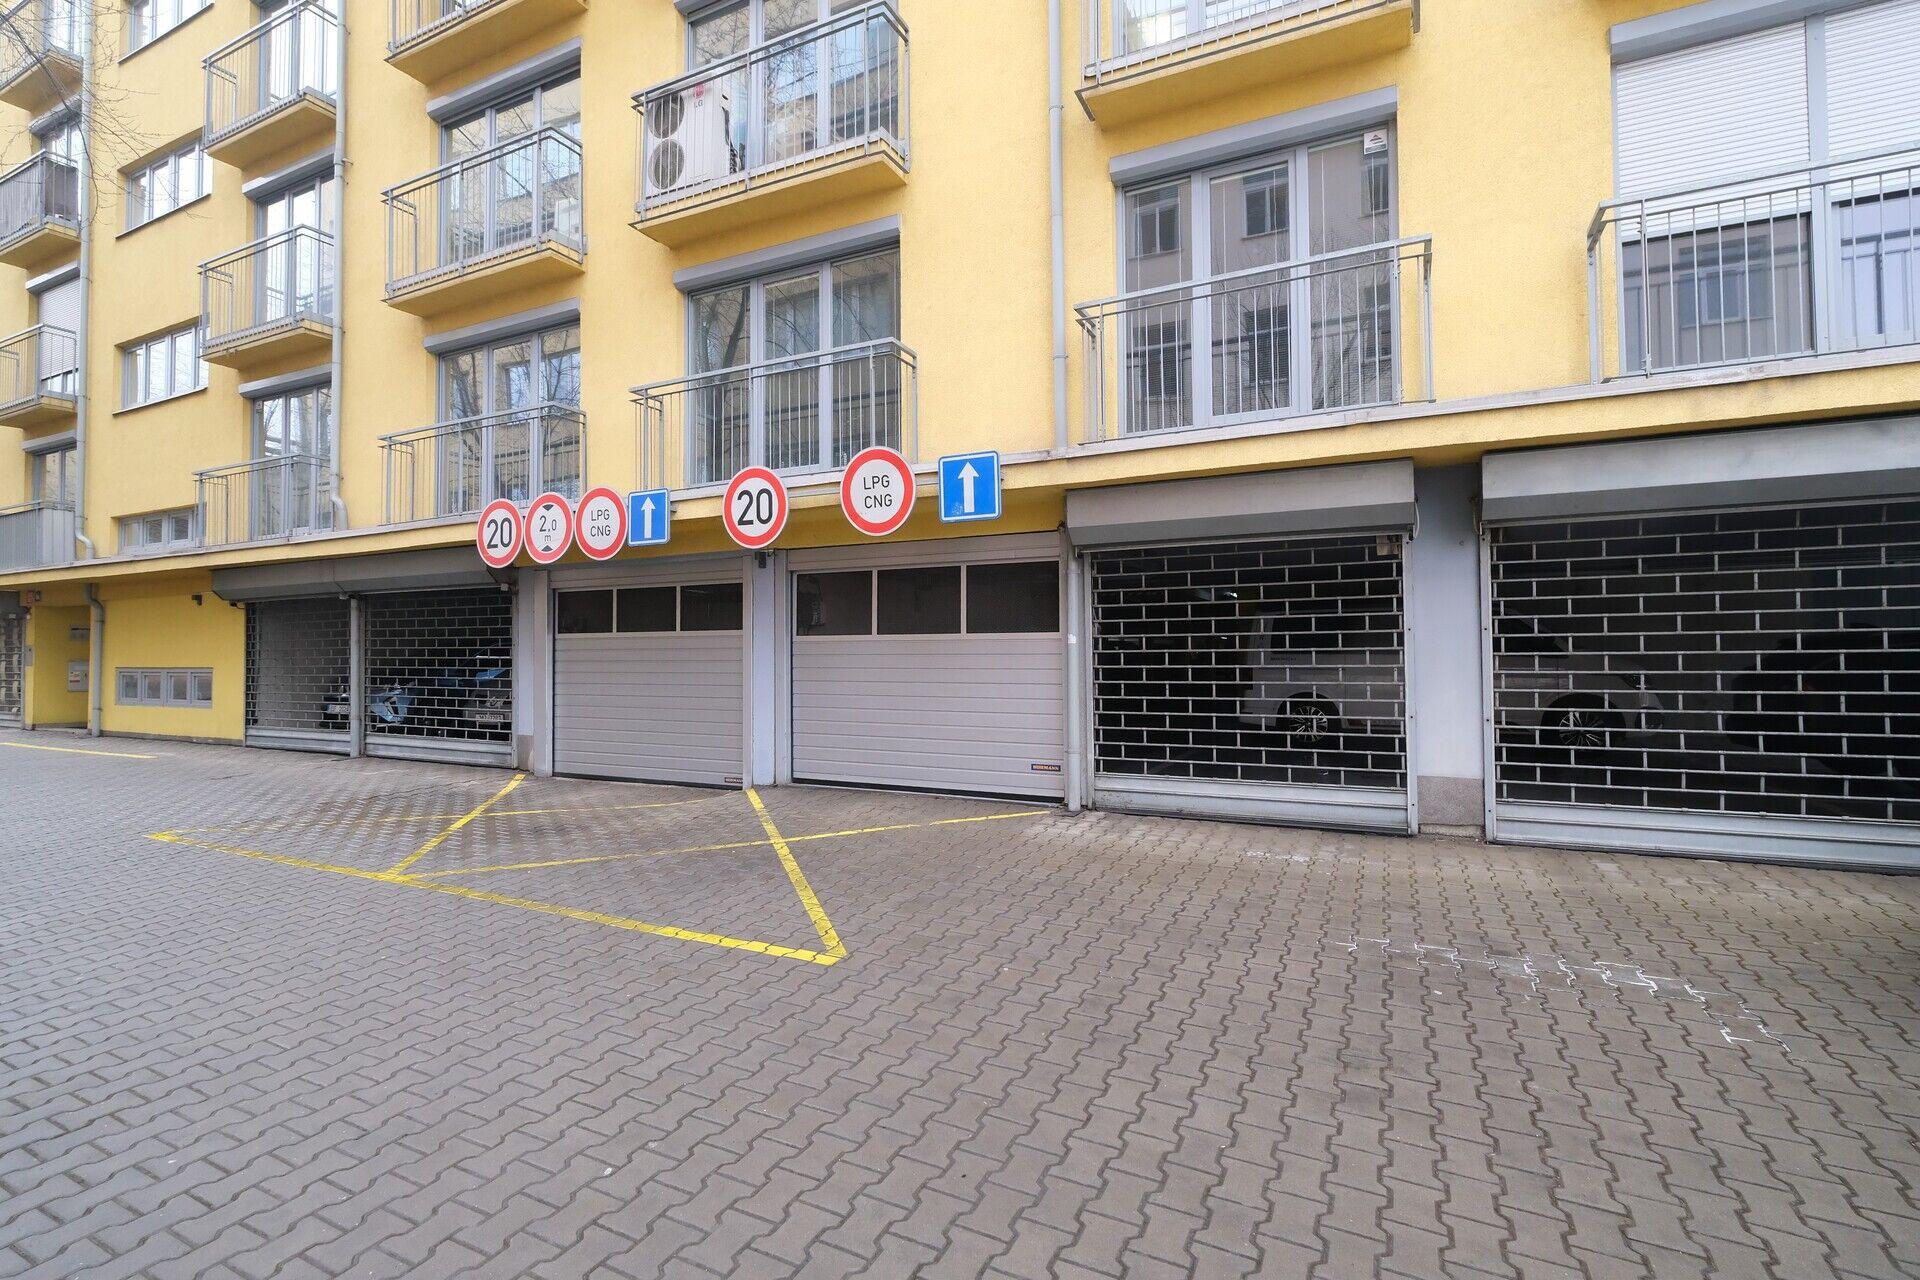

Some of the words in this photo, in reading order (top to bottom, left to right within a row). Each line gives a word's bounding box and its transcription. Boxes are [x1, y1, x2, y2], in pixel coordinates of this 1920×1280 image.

[863, 474, 890, 490] LPG
[737, 488, 773, 526] 20
[864, 493, 893, 509] CNG
[590, 508, 610, 522] LPG
[539, 515, 557, 533] 2,0
[590, 525, 611, 538] CNG
[486, 517, 513, 550] 20
[544, 535, 552, 543] m
